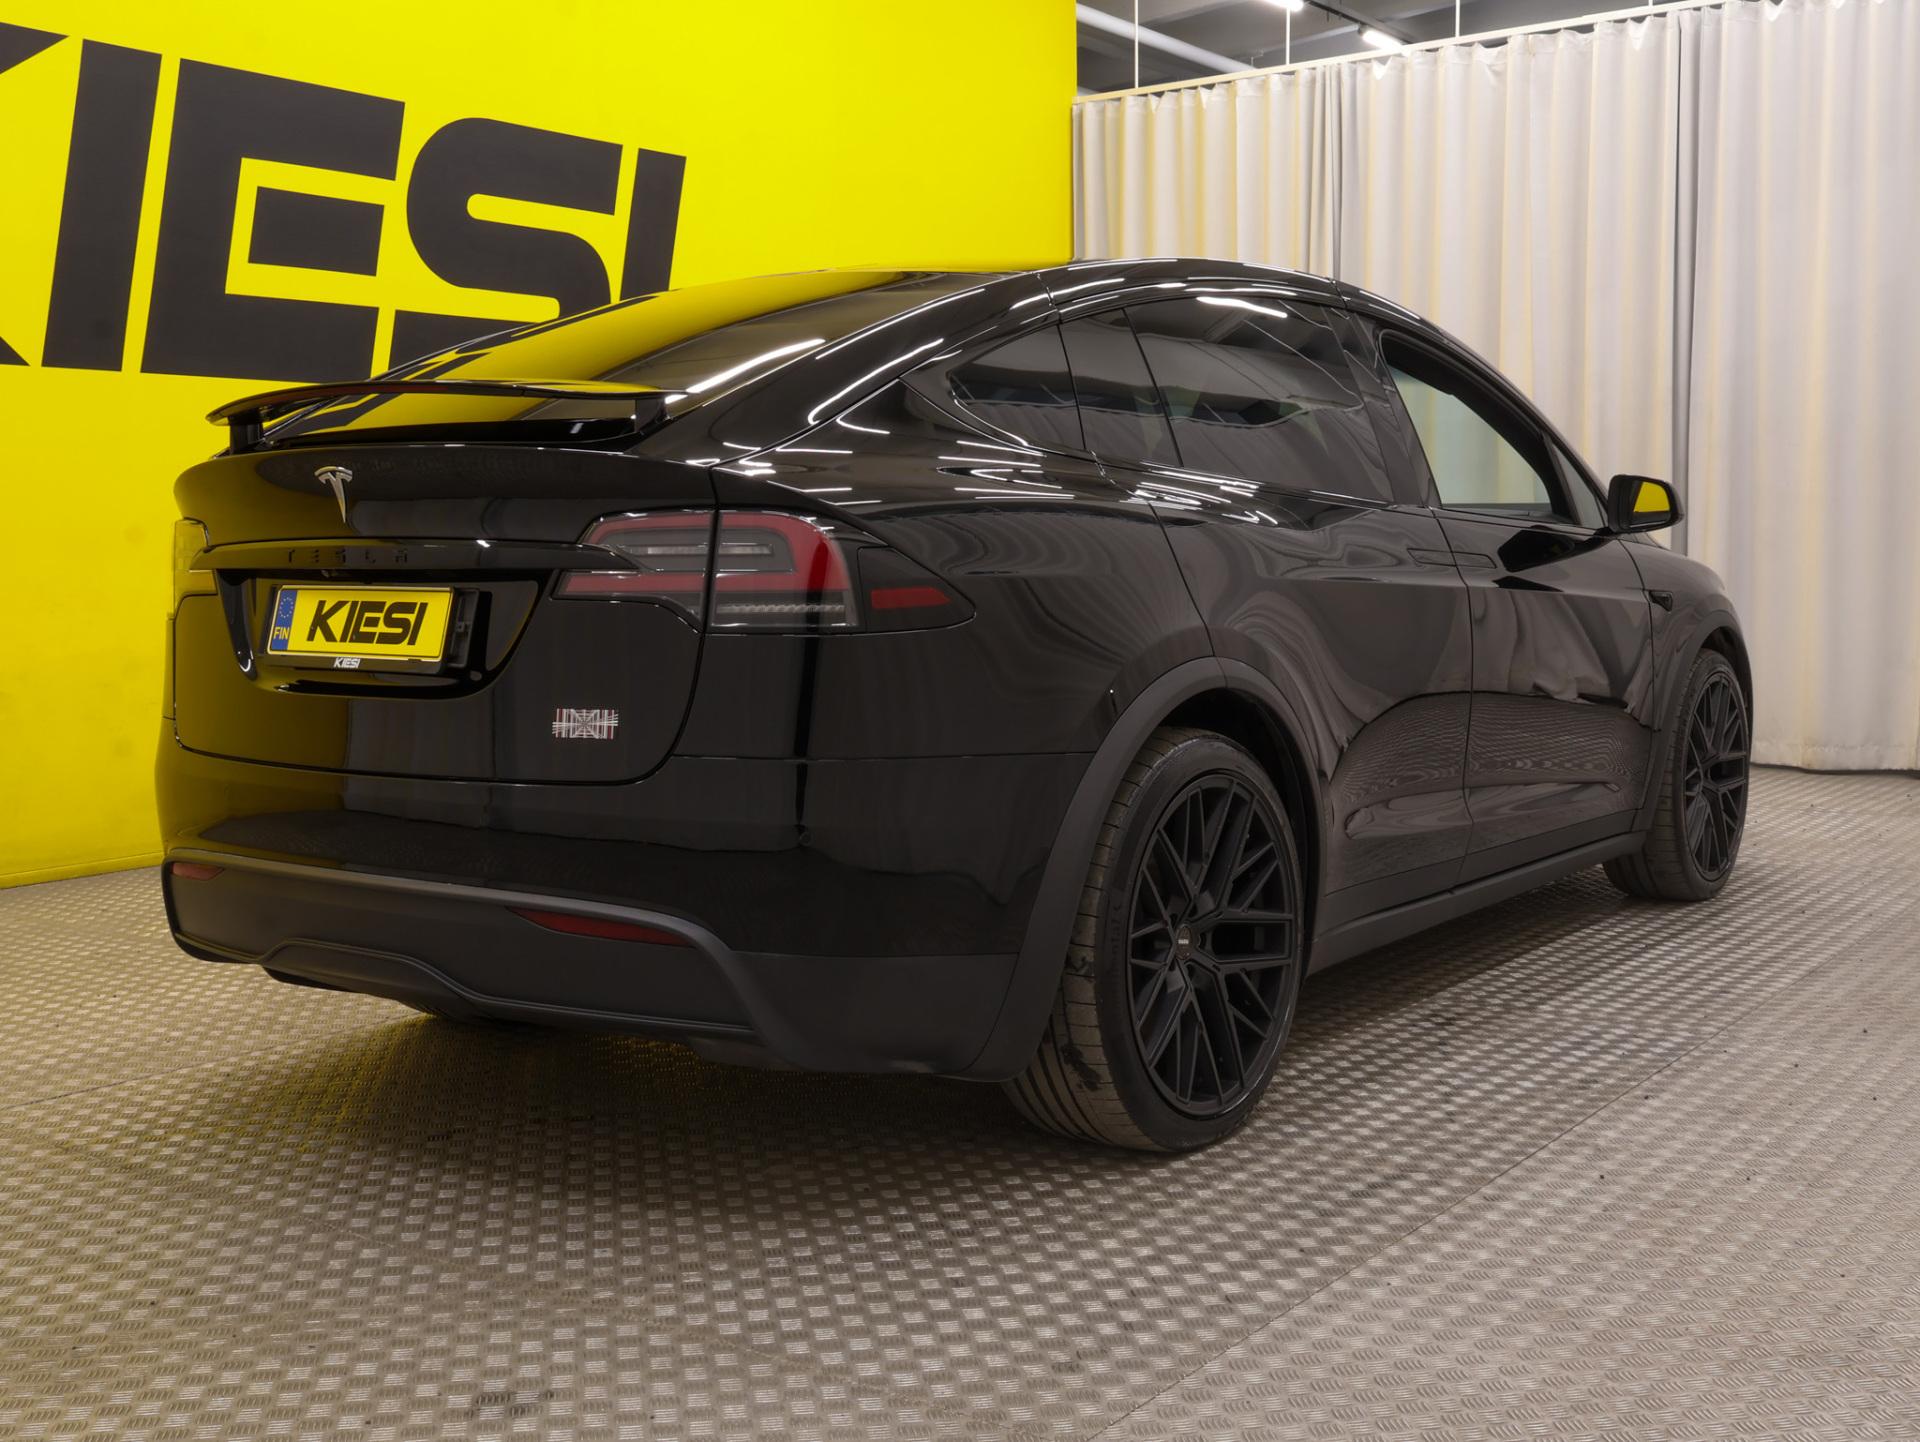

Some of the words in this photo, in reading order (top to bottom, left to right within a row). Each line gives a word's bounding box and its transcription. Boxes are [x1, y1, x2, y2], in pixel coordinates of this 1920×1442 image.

[0, 22, 687, 383] IESI
[273, 627, 290, 640] FIN
[306, 600, 428, 645] KIESI
[333, 657, 361, 669] KIESI
